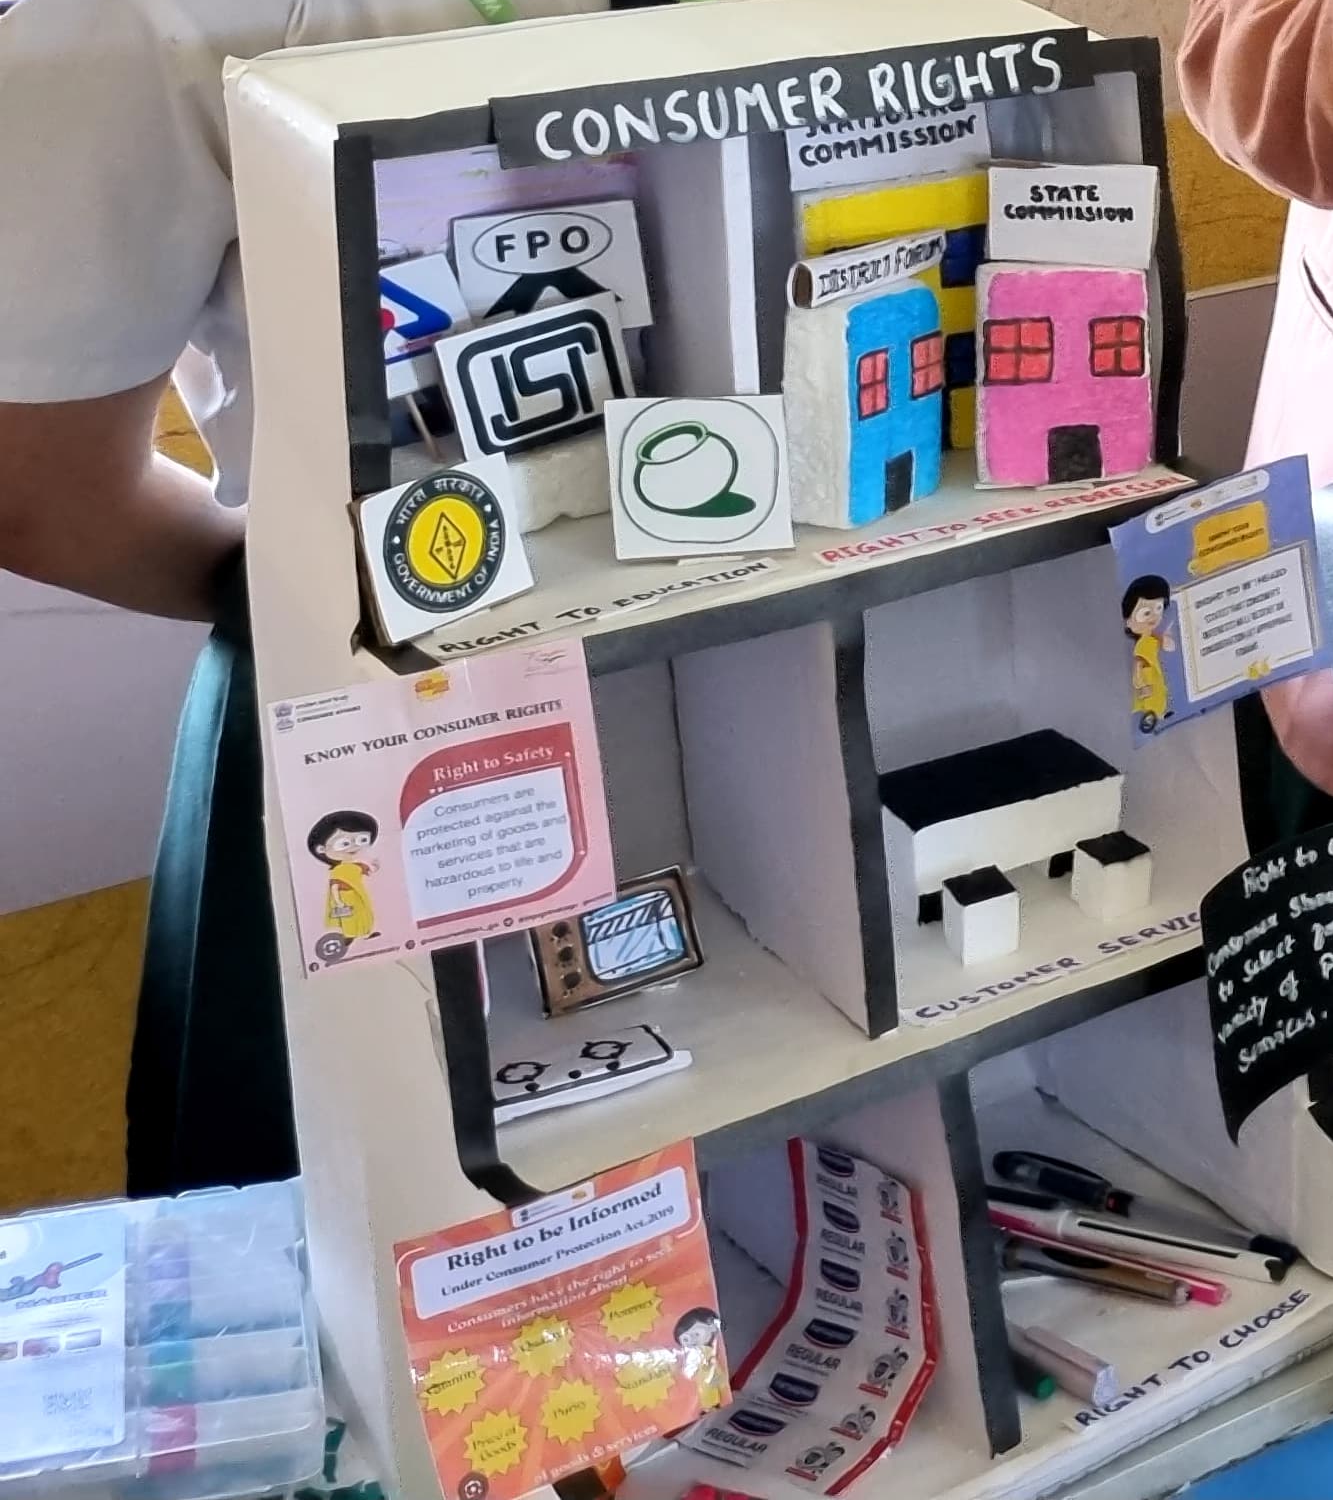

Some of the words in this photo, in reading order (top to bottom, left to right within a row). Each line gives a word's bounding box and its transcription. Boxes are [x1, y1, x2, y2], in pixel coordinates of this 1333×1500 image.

[534, 65, 849, 162] CONSUMER
[867, 35, 1064, 119] RIGHTS
[797, 113, 979, 168] COMMISSION
[1029, 183, 1101, 205] STATE
[494, 225, 592, 263] FPO
[820, 529, 924, 565] RIGHT
[930, 518, 970, 539] TO
[972, 503, 1041, 529] SEEK
[393, 552, 474, 604] GOVERNMENT
[474, 565, 489, 586] OF
[485, 518, 501, 563] INDIA
[437, 619, 543, 656] RIGHT
[556, 602, 604, 623] TO
[611, 561, 771, 609] EDUCATION
[303, 743, 358, 766] KNOW
[361, 732, 409, 753] YOUR
[412, 711, 502, 742] CONSUMER
[504, 699, 564, 722] RIGHTS
[431, 760, 480, 784] Right
[481, 756, 501, 770] to
[503, 745, 555, 768] Safety
[416, 815, 481, 841] protected
[484, 804, 533, 825] against
[535, 799, 558, 813] the
[433, 790, 511, 819] Consumers
[512, 786, 536, 800] are
[409, 834, 478, 858] marketing
[479, 827, 494, 842] of
[496, 821, 540, 841] goods
[541, 813, 568, 829] and
[437, 848, 494, 870] services
[496, 840, 522, 856] that
[524, 836, 547, 850] are
[424, 864, 497, 890] hazardous
[497, 860, 513, 874] to
[513, 853, 535, 869] life
[536, 849, 564, 866] and
[1242, 856, 1288, 900] Right
[1294, 845, 1319, 868] to
[915, 956, 1082, 1020] CUSTOMER
[1096, 910, 1201, 955] SERVIC
[1278, 969, 1300, 1003] of
[445, 1242, 508, 1272] Right
[512, 1233, 536, 1252] to
[538, 1221, 565, 1243] be
[567, 1181, 663, 1233] Informed
[820, 1228, 866, 1256] REGULAR
[440, 1278, 483, 1298] Under
[484, 1253, 553, 1283] Consumer
[554, 1227, 623, 1260] Protection
[447, 1296, 529, 1335] Consumers
[530, 1283, 567, 1306] have
[566, 1277, 591, 1296] the
[591, 1262, 627, 1286] right
[628, 1253, 646, 1270] to
[499, 1290, 589, 1330] information
[815, 1287, 863, 1313] REGULAR
[785, 1343, 842, 1371] REGULAR
[1074, 1371, 1166, 1428] RIGHT
[1169, 1349, 1211, 1373] TO
[1219, 1289, 1311, 1349] CHOOSE
[606, 1424, 659, 1452] services
[704, 1427, 769, 1456] REGULAR
